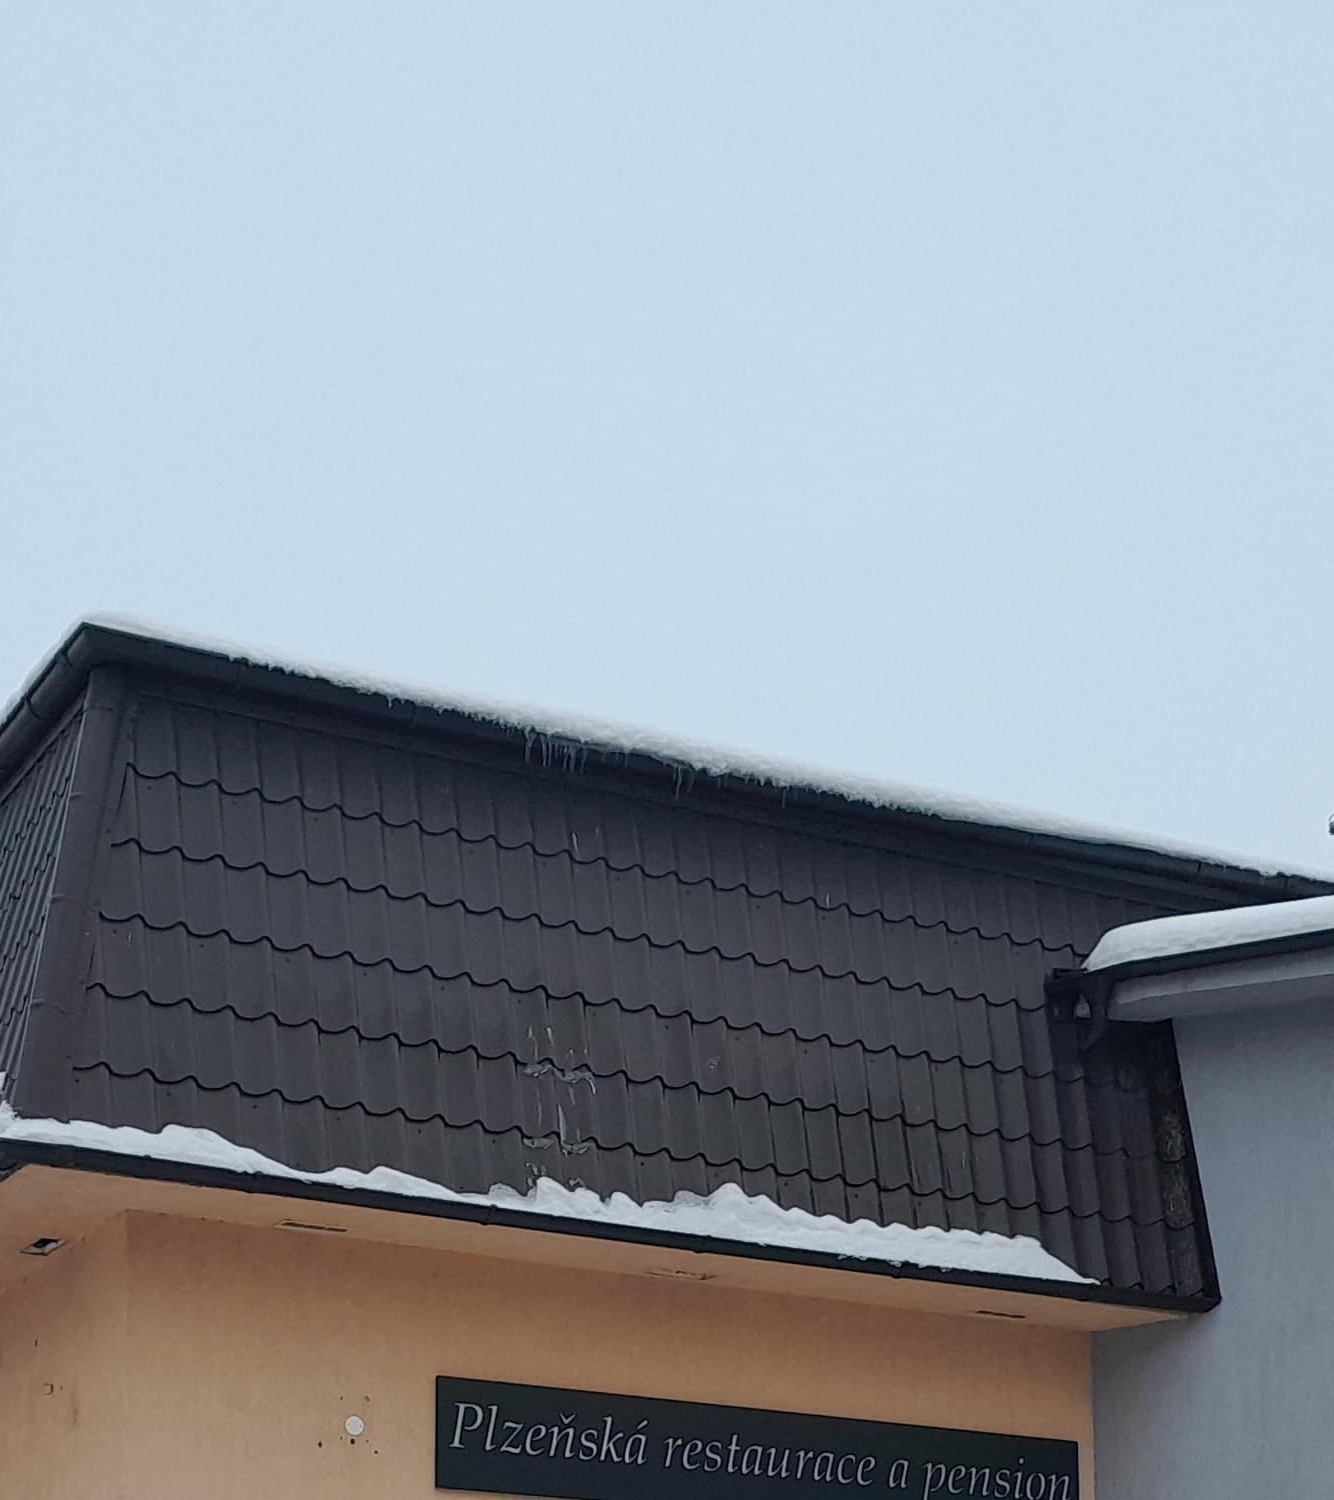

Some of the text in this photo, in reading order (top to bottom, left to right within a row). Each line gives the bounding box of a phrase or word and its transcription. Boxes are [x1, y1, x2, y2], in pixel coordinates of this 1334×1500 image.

[448, 1401, 649, 1466] Plzeňská
[664, 1432, 876, 1487] restaurace
[887, 1457, 909, 1488] a
